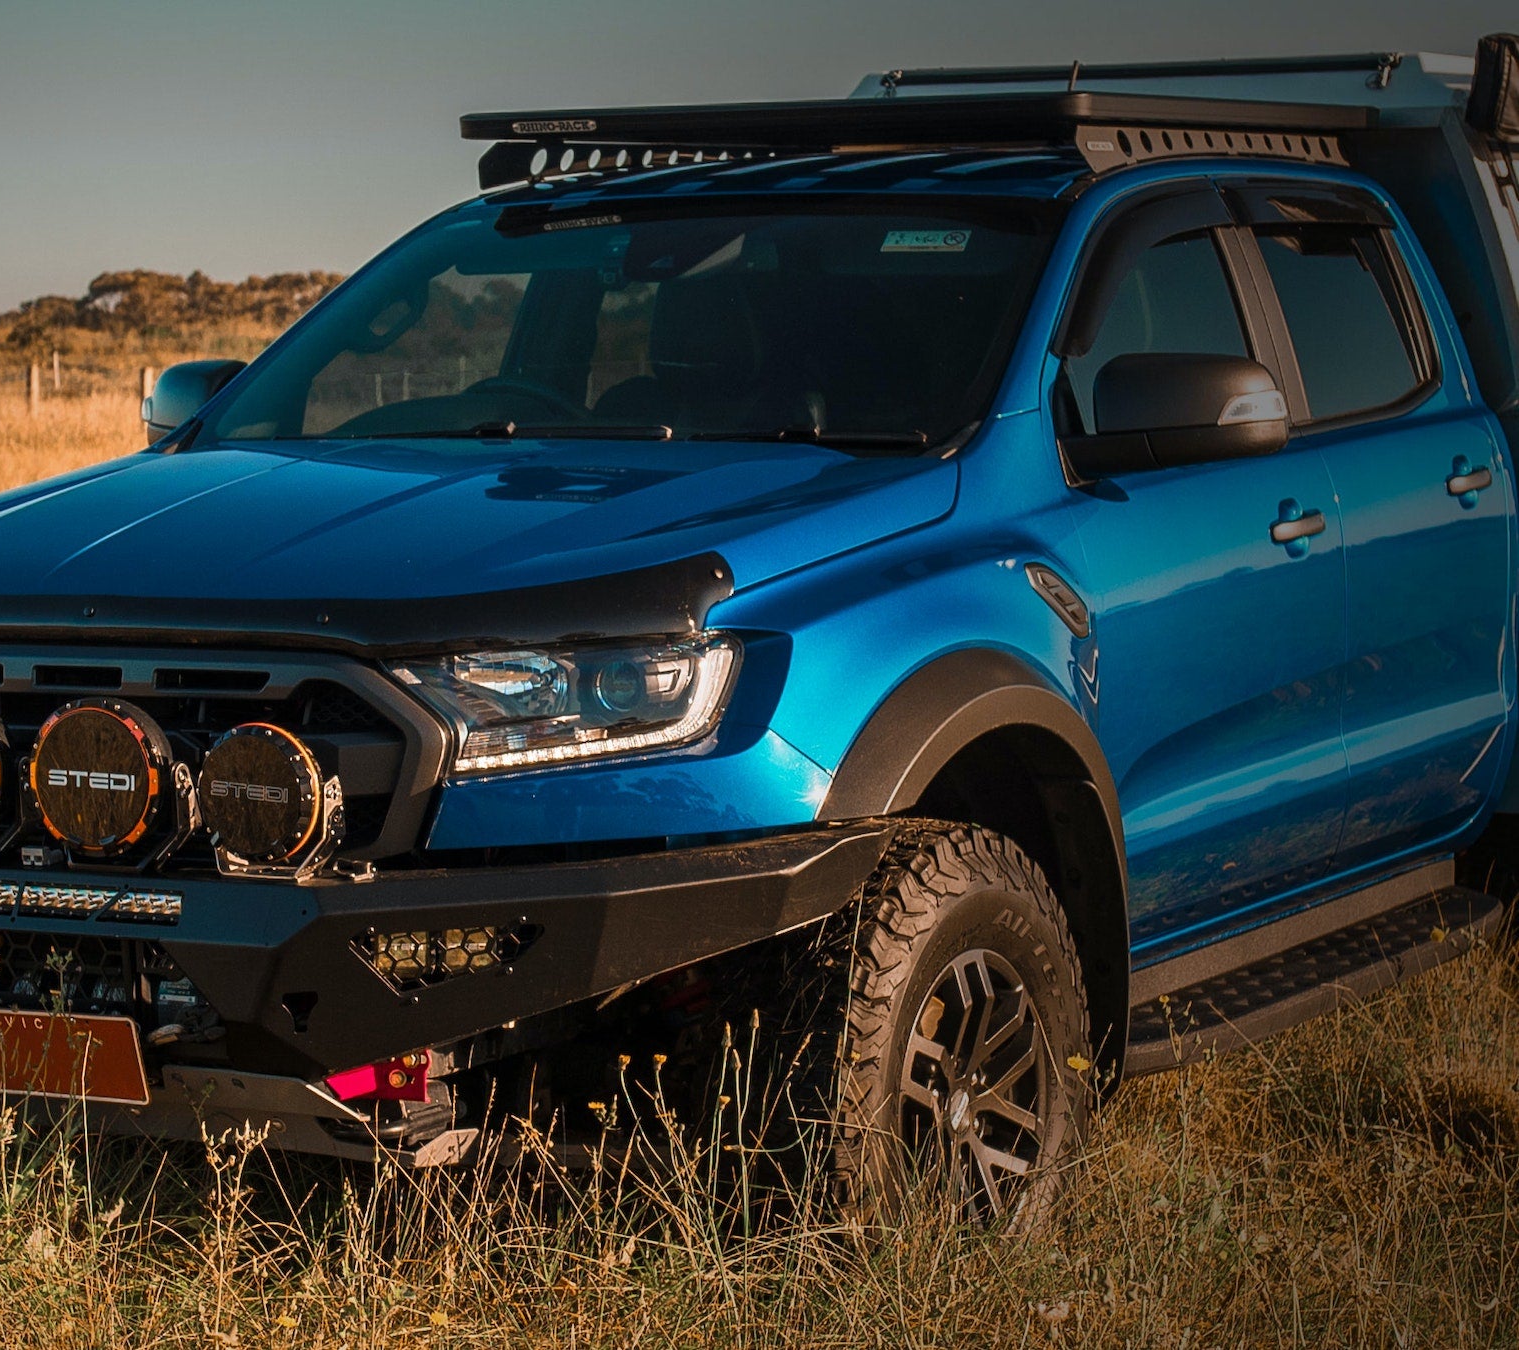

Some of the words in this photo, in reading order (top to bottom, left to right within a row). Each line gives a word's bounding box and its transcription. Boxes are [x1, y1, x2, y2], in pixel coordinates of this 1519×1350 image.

[520, 121, 589, 132] RHINO-RACK
[48, 769, 135, 791] STEDI
[210, 780, 288, 804] STEDI
[4, 1016, 43, 1029] VIC
